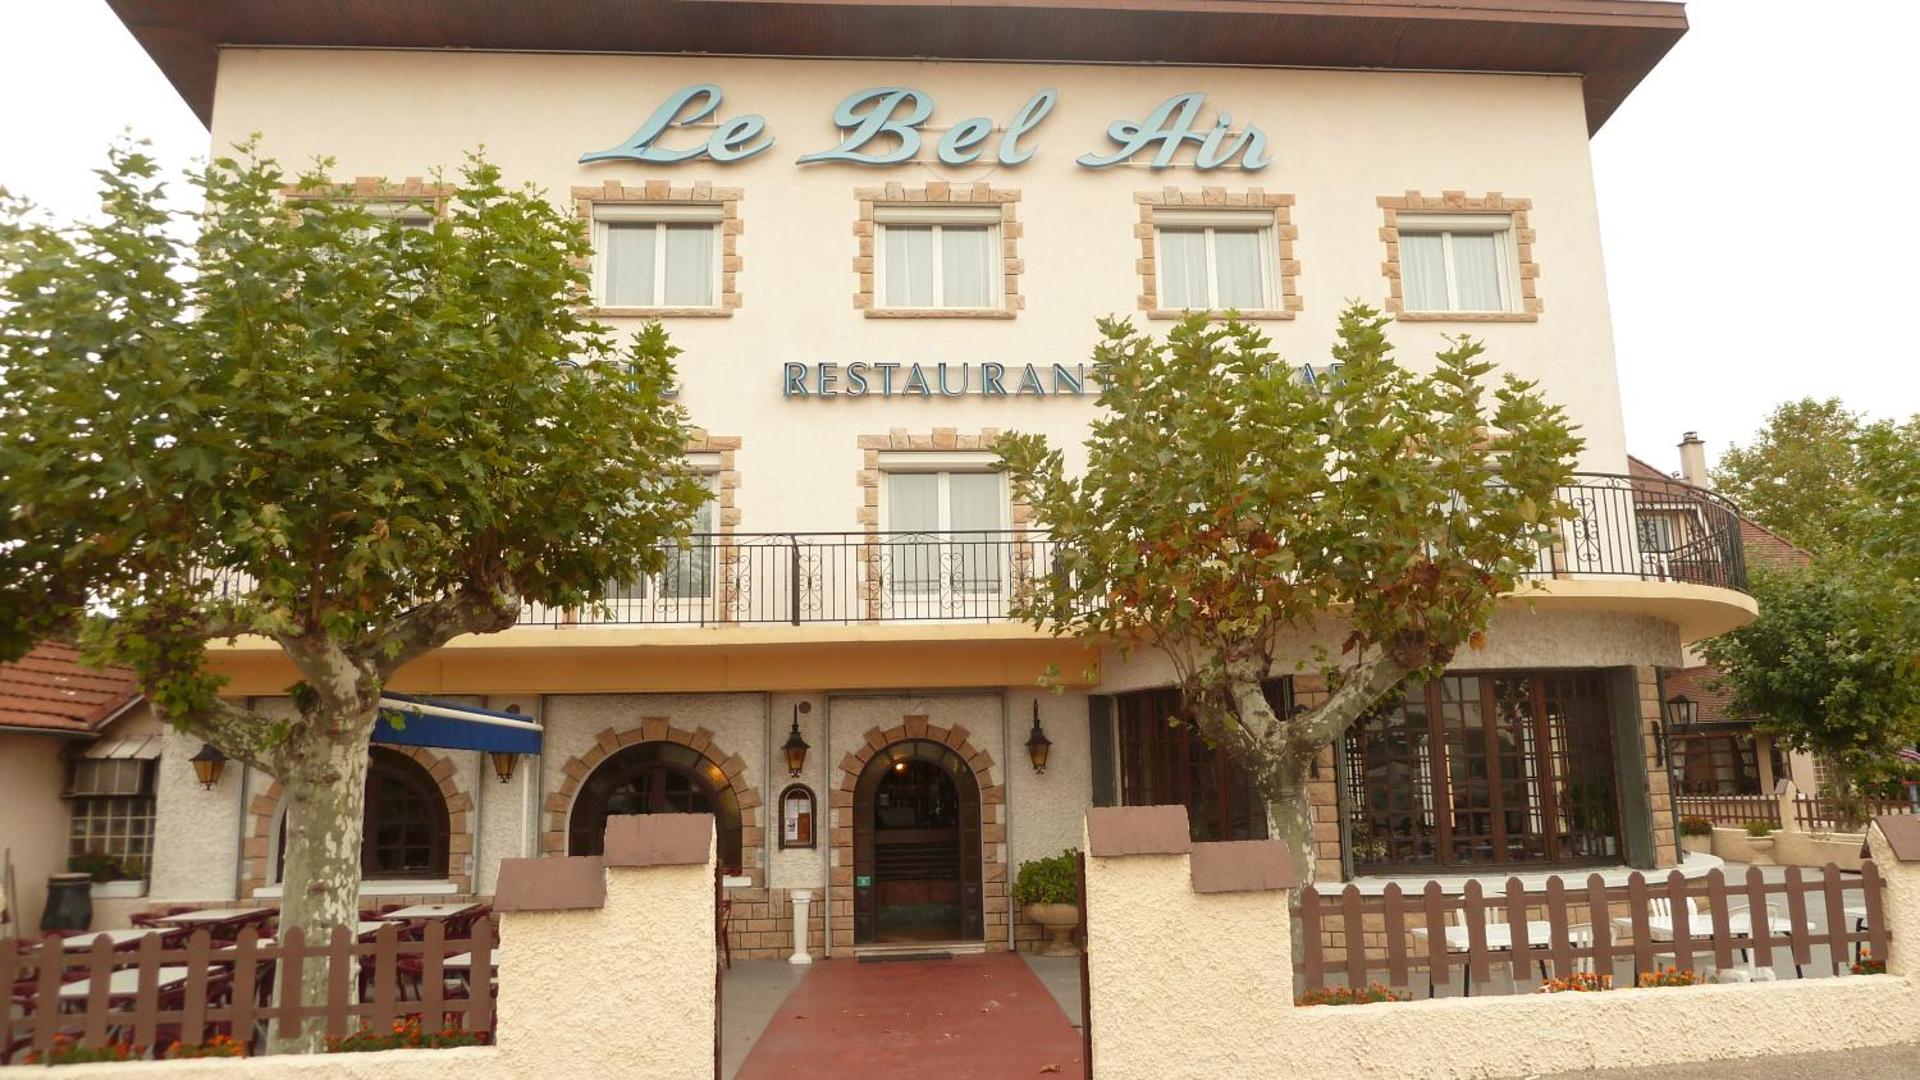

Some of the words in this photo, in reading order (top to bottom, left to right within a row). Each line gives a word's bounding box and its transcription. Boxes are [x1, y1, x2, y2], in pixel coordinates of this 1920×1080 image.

[578, 83, 776, 164] Le
[796, 86, 1059, 166] Bel
[1076, 91, 1271, 171] Air
